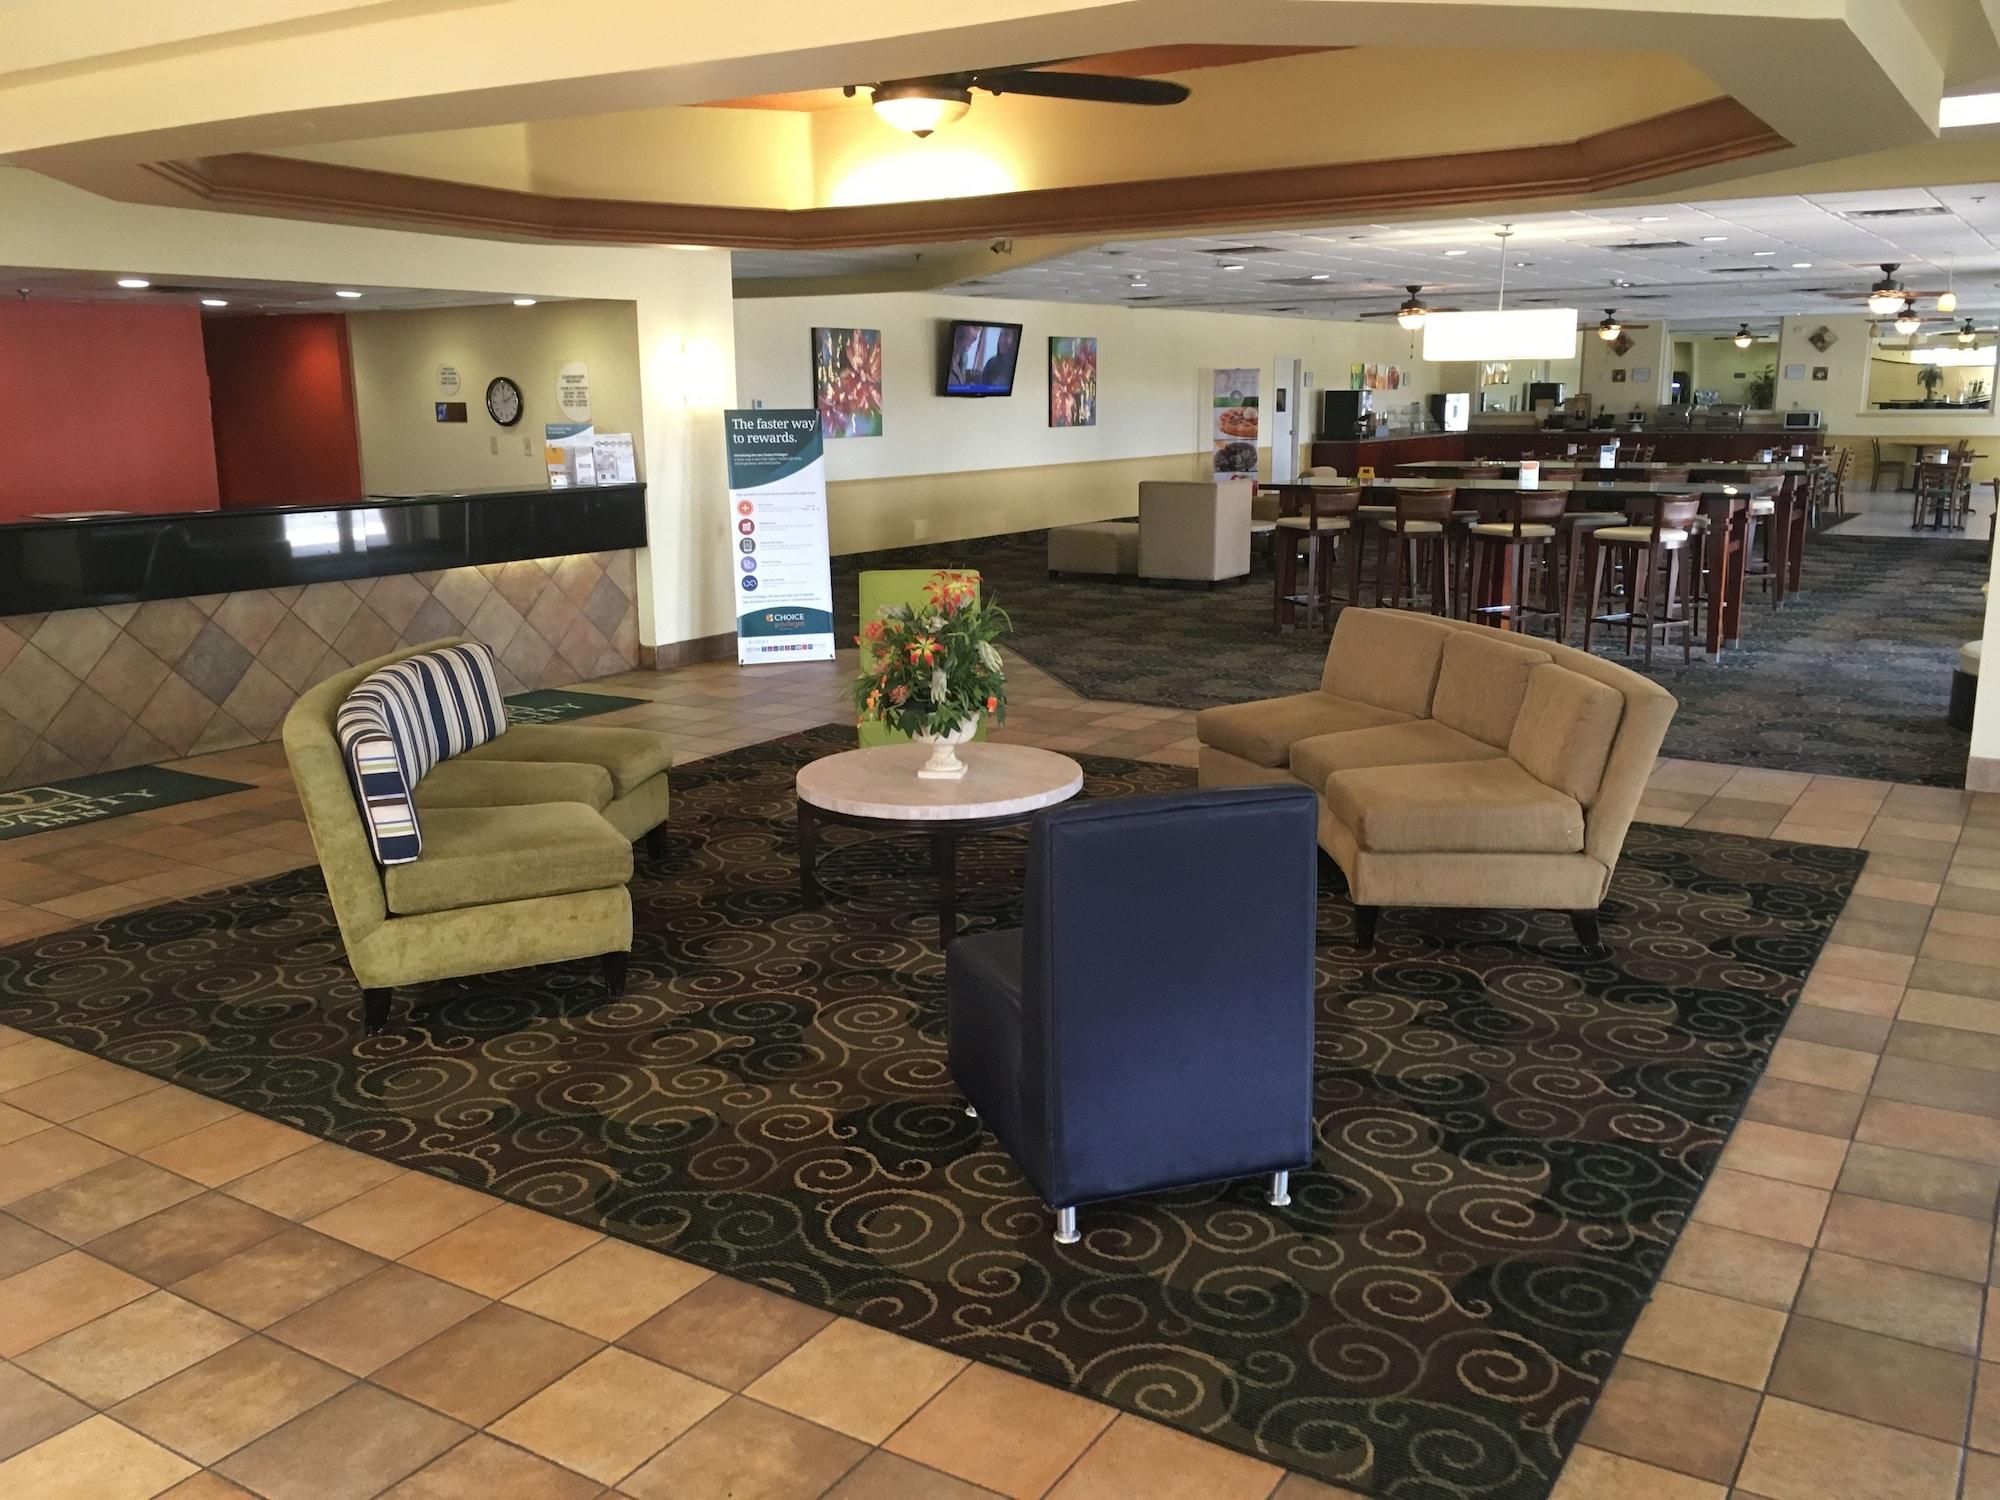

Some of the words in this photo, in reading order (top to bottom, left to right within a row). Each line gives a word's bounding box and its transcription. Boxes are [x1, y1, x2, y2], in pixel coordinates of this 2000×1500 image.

[732, 418, 754, 430] The
[757, 418, 789, 430] faster
[792, 419, 815, 432] way
[733, 433, 744, 443] to
[747, 431, 797, 443] rewards.
[774, 613, 805, 622] CHOICE
